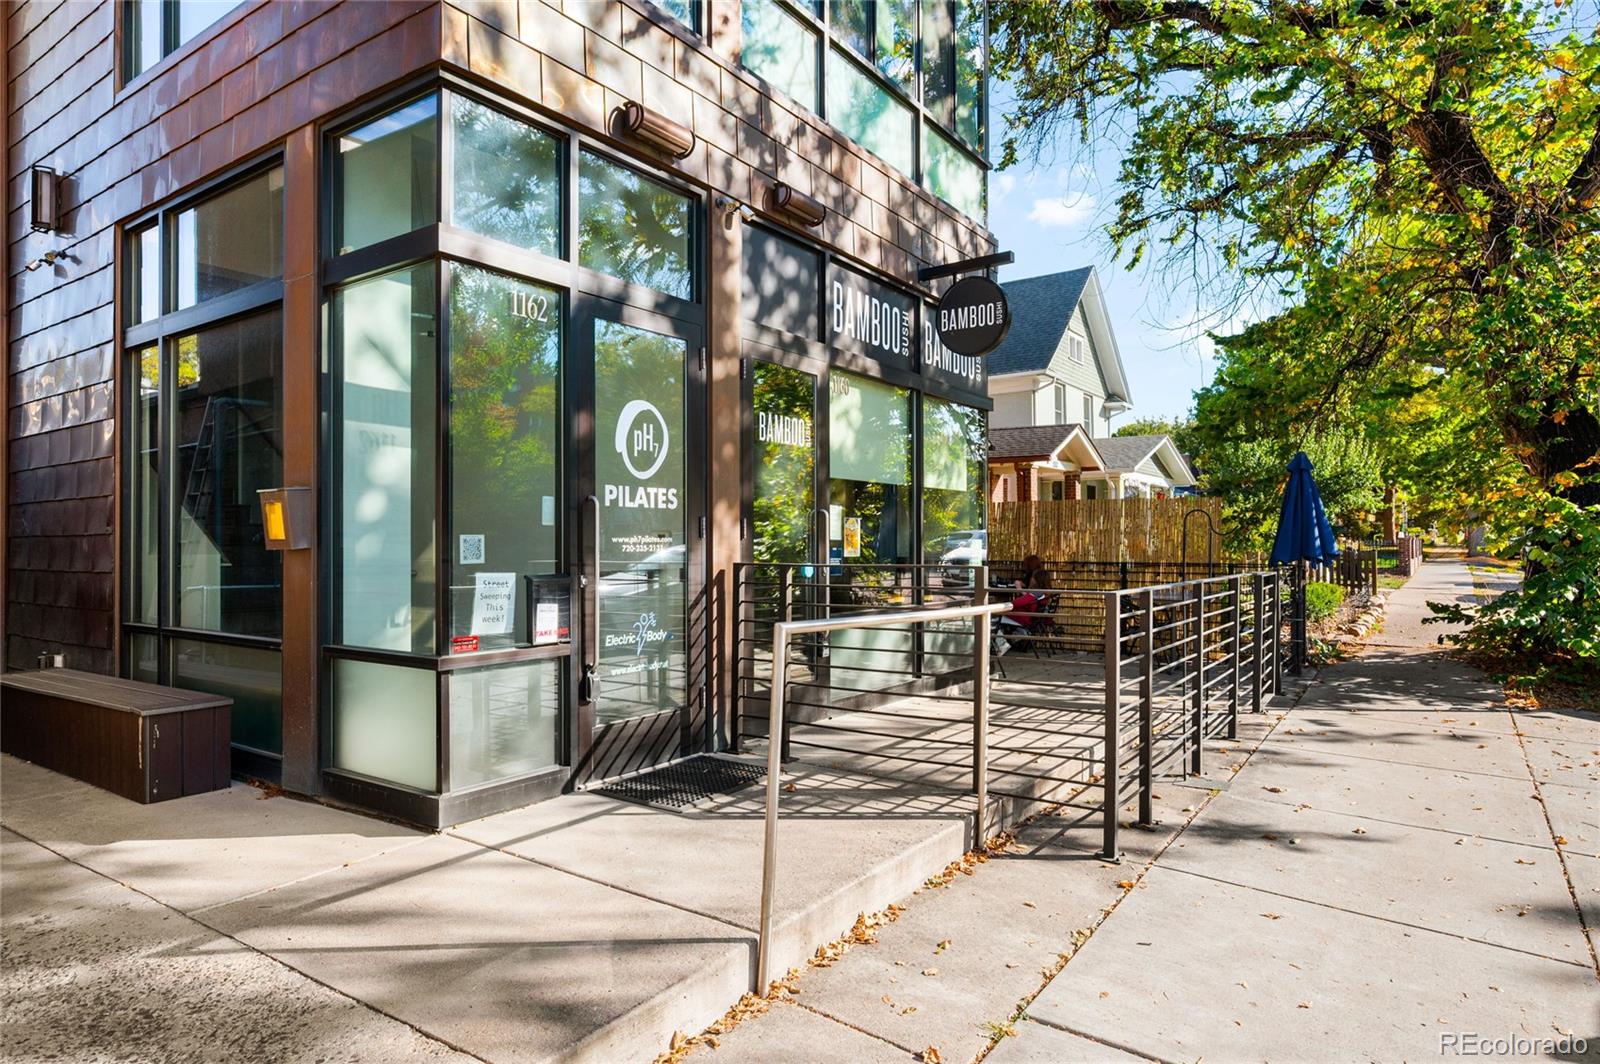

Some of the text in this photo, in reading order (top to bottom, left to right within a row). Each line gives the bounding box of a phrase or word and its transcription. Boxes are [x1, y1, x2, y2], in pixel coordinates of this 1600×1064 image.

[511, 290, 548, 323] 1162
[941, 301, 1004, 332] BAMBOO SUSHI
[833, 281, 910, 357] BAMBOO SUSHI
[759, 411, 805, 448] BAMBOO
[604, 484, 678, 510] PILATES
[611, 535, 673, 544] www.ph7pilates.com
[482, 580, 510, 589] Street
[479, 592, 512, 601] Sweeping
[486, 603, 504, 612] This
[605, 633, 637, 647] Electric
[646, 629, 667, 642] Body
